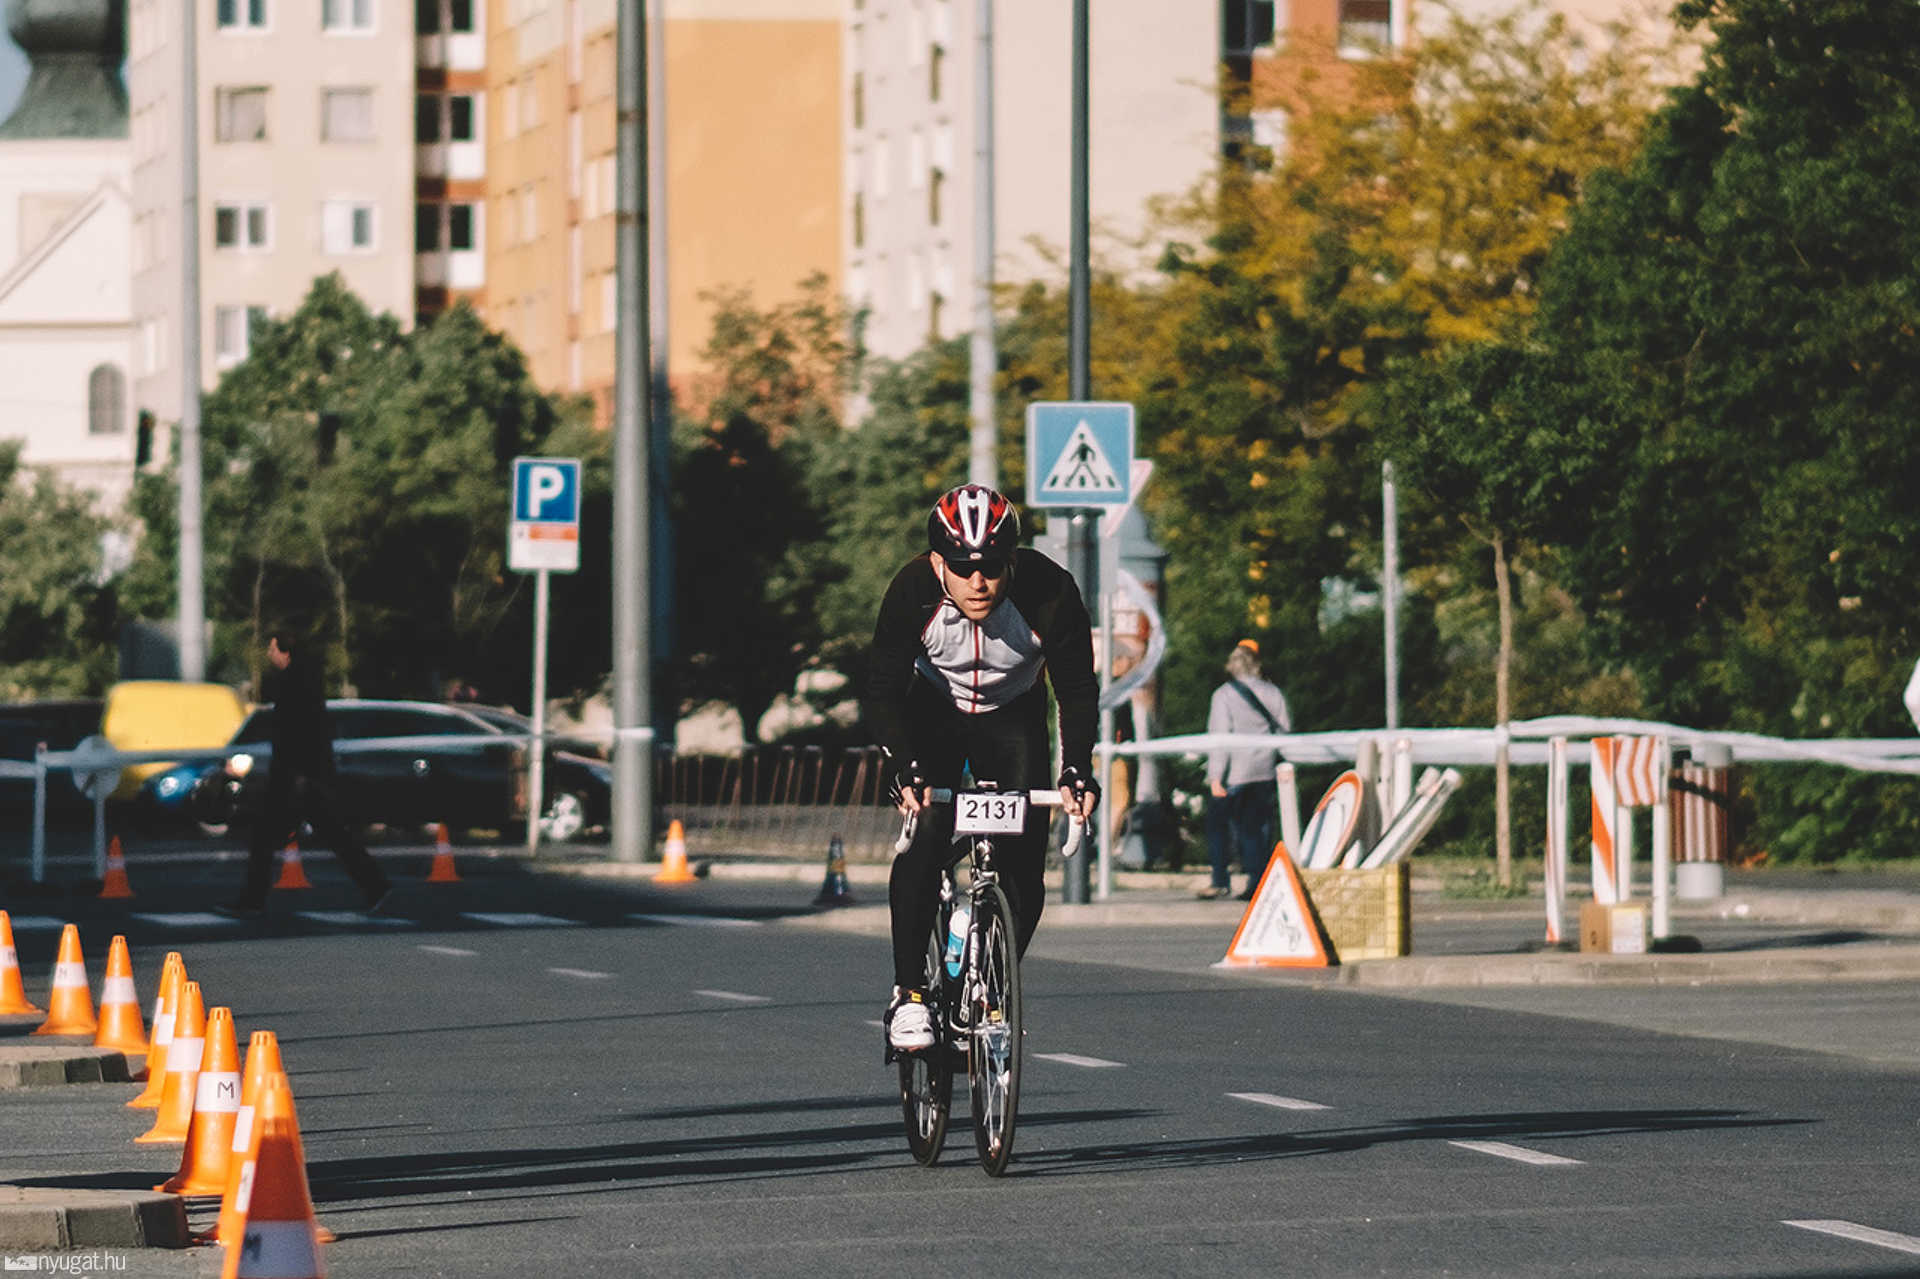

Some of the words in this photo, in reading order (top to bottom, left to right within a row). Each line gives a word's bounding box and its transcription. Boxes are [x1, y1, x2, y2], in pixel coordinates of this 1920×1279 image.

[529, 466, 564, 518] P
[965, 799, 1017, 820] 2131
[217, 1081, 235, 1099] M
